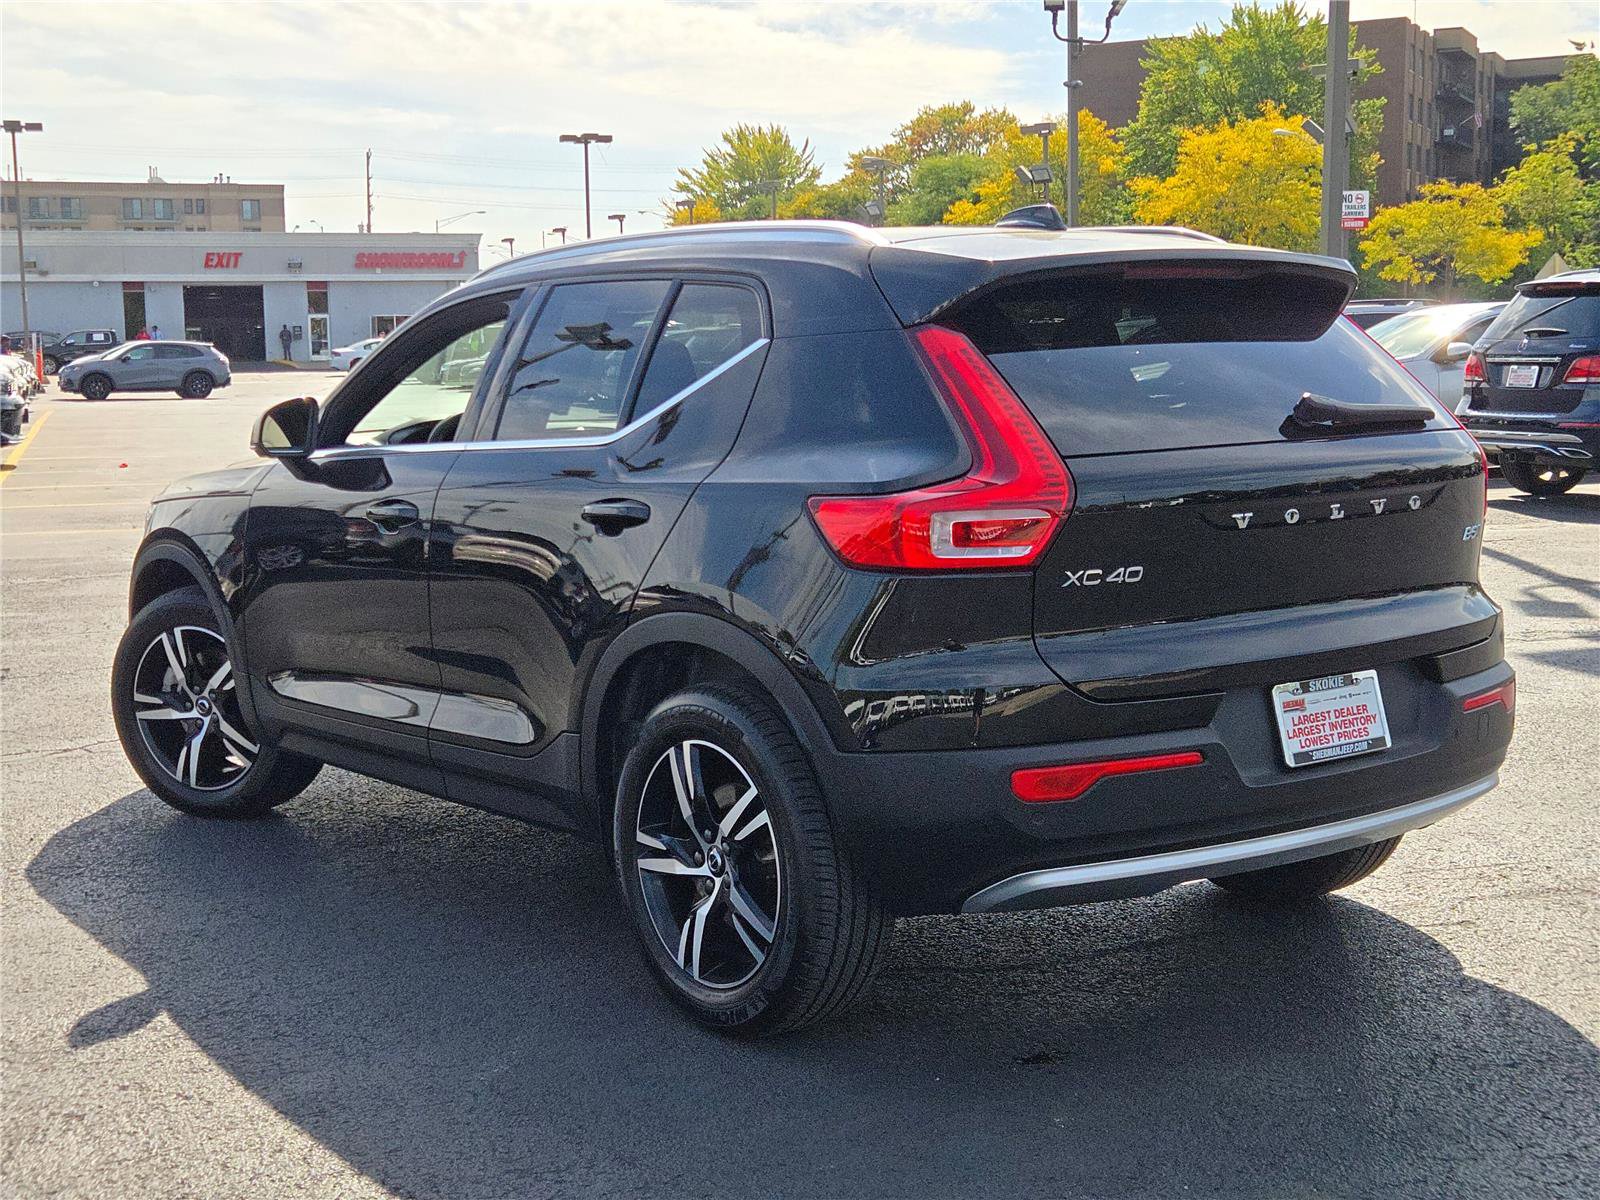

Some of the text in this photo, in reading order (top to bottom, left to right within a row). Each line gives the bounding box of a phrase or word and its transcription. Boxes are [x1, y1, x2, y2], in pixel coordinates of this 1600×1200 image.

[1342, 193, 1353, 204] NO
[204, 252, 242, 269] EXIT
[1231, 495, 1421, 529] VOLVO
[1462, 523, 1481, 541] B5
[1309, 676, 1345, 692] SKOKIE
[1291, 704, 1369, 727] LARGEST DEALER
[1287, 714, 1377, 740] LARGEST INVENTORY
[1299, 727, 1370, 749] LOWEST PRICES
[1312, 741, 1369, 760] SHERMANJEEP.COM
